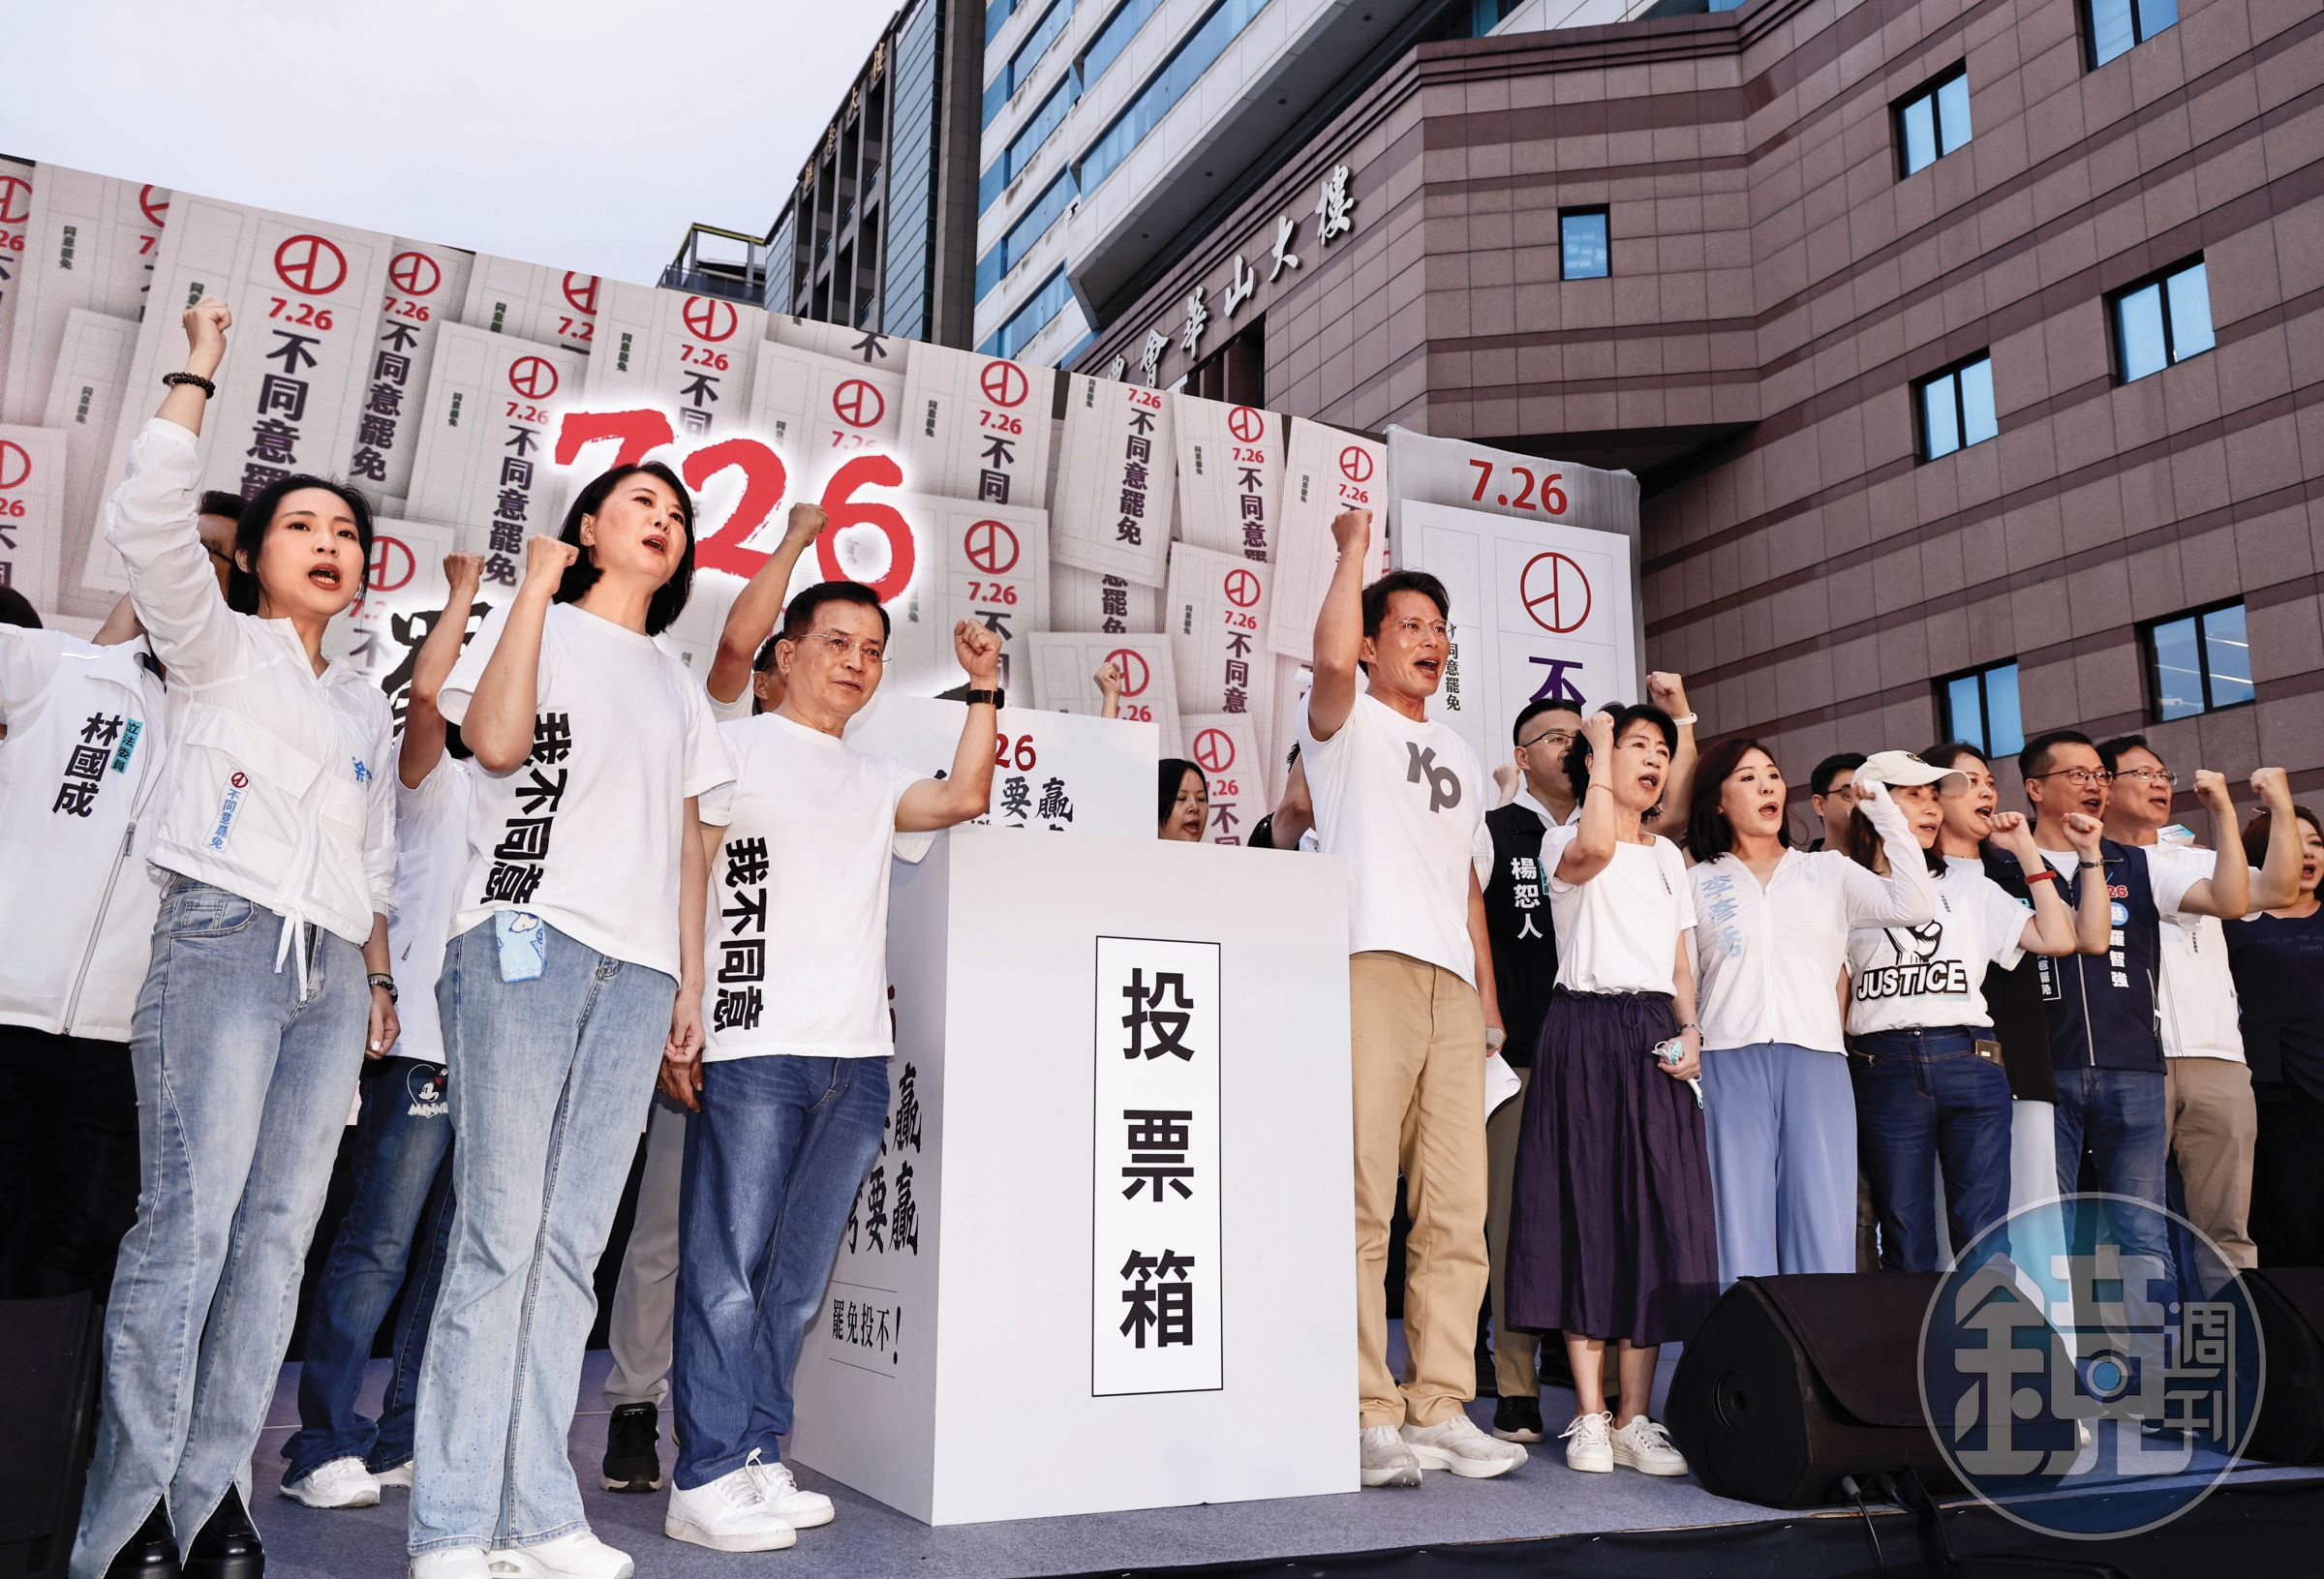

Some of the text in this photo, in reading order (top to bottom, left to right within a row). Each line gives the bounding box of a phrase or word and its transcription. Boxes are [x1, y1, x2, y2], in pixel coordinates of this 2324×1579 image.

[268, 297, 333, 331] 7.26
[383, 296, 430, 322] 7.26
[680, 344, 729, 372] 7.26
[350, 319, 420, 482] 不同意罷免
[505, 401, 549, 425] 7.26
[980, 410, 1023, 435] 7.26
[1128, 388, 1161, 410] 7.26
[978, 435, 1016, 504] 不同
[1116, 408, 1156, 546] 不同意罷免
[1233, 447, 1265, 464] 7.26
[483, 424, 540, 587] 不同意罷免
[1338, 483, 1368, 503] 7.26
[1468, 458, 1568, 515] 7.26
[968, 582, 1017, 605] 7.26
[1224, 611, 1257, 629] 7.26
[1222, 631, 1252, 714] 不同意
[1445, 643, 1461, 712] 同意罷免
[1528, 655, 1587, 706] 不
[52, 712, 123, 817] 林國成
[111, 722, 139, 773] 立法委員
[209, 788, 241, 849] 不同意罷免
[1511, 857, 1544, 940] 楊恕人
[713, 836, 770, 1033] 我不同意
[1857, 959, 1969, 1001] JUSTICE
[1119, 968, 1196, 1350] 投票箱
